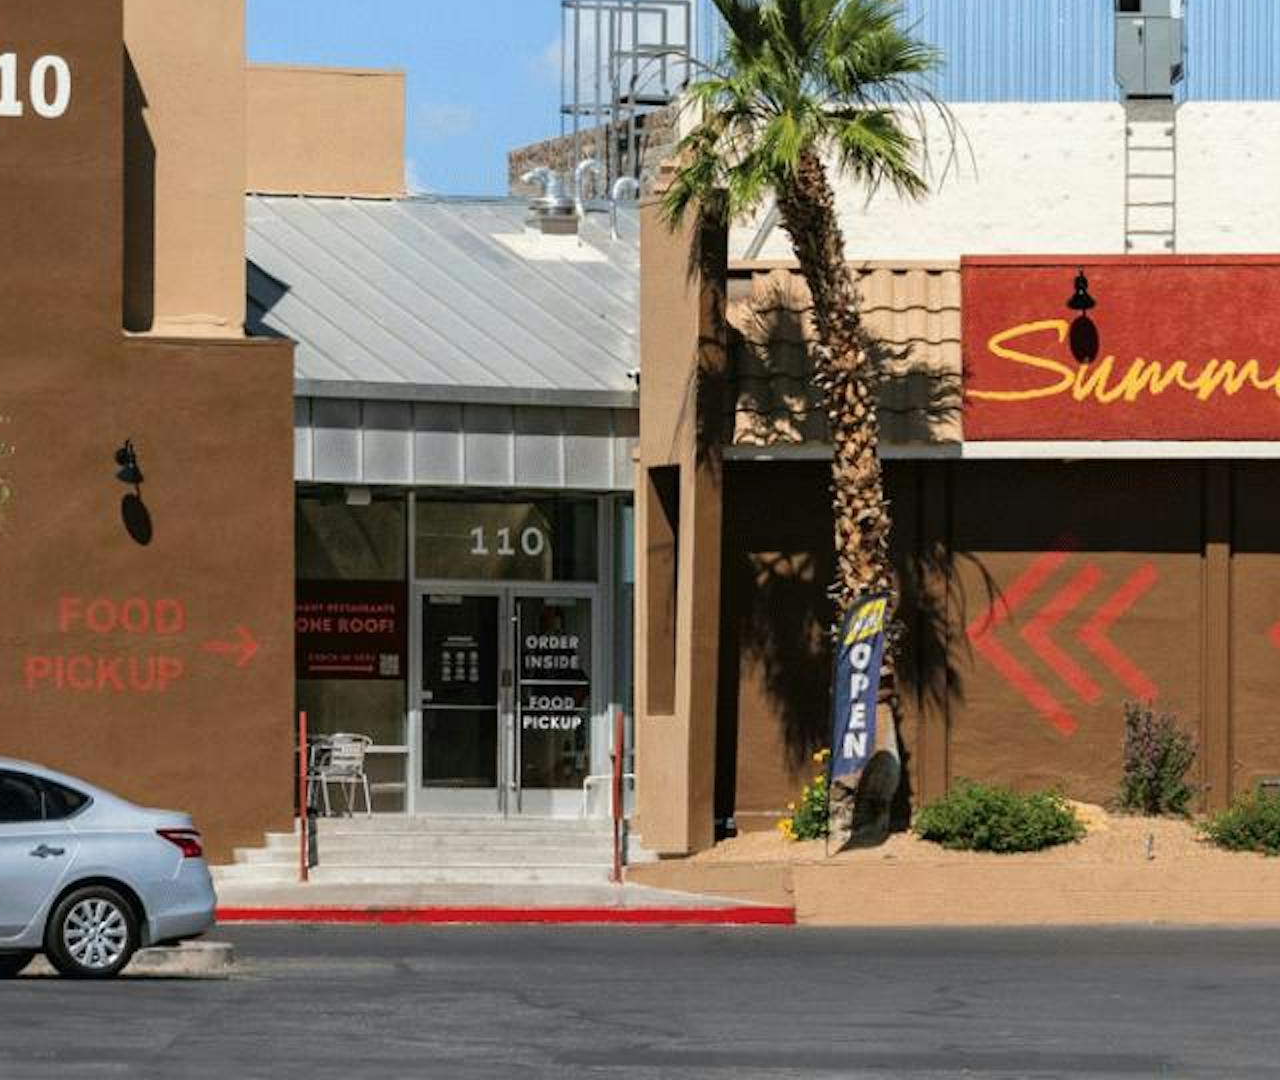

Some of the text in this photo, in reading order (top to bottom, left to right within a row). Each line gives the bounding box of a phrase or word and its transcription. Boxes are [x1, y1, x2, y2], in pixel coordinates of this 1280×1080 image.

[470, 526, 544, 555] 110
[59, 596, 186, 633] FOOD
[295, 617, 332, 633] ONE
[525, 634, 580, 650] ORDER
[525, 654, 579, 670] INSIDE
[25, 655, 184, 691] PICKUP
[529, 695, 576, 711] FOOD
[843, 642, 872, 758] OPEN
[523, 715, 583, 730] PICKUP
